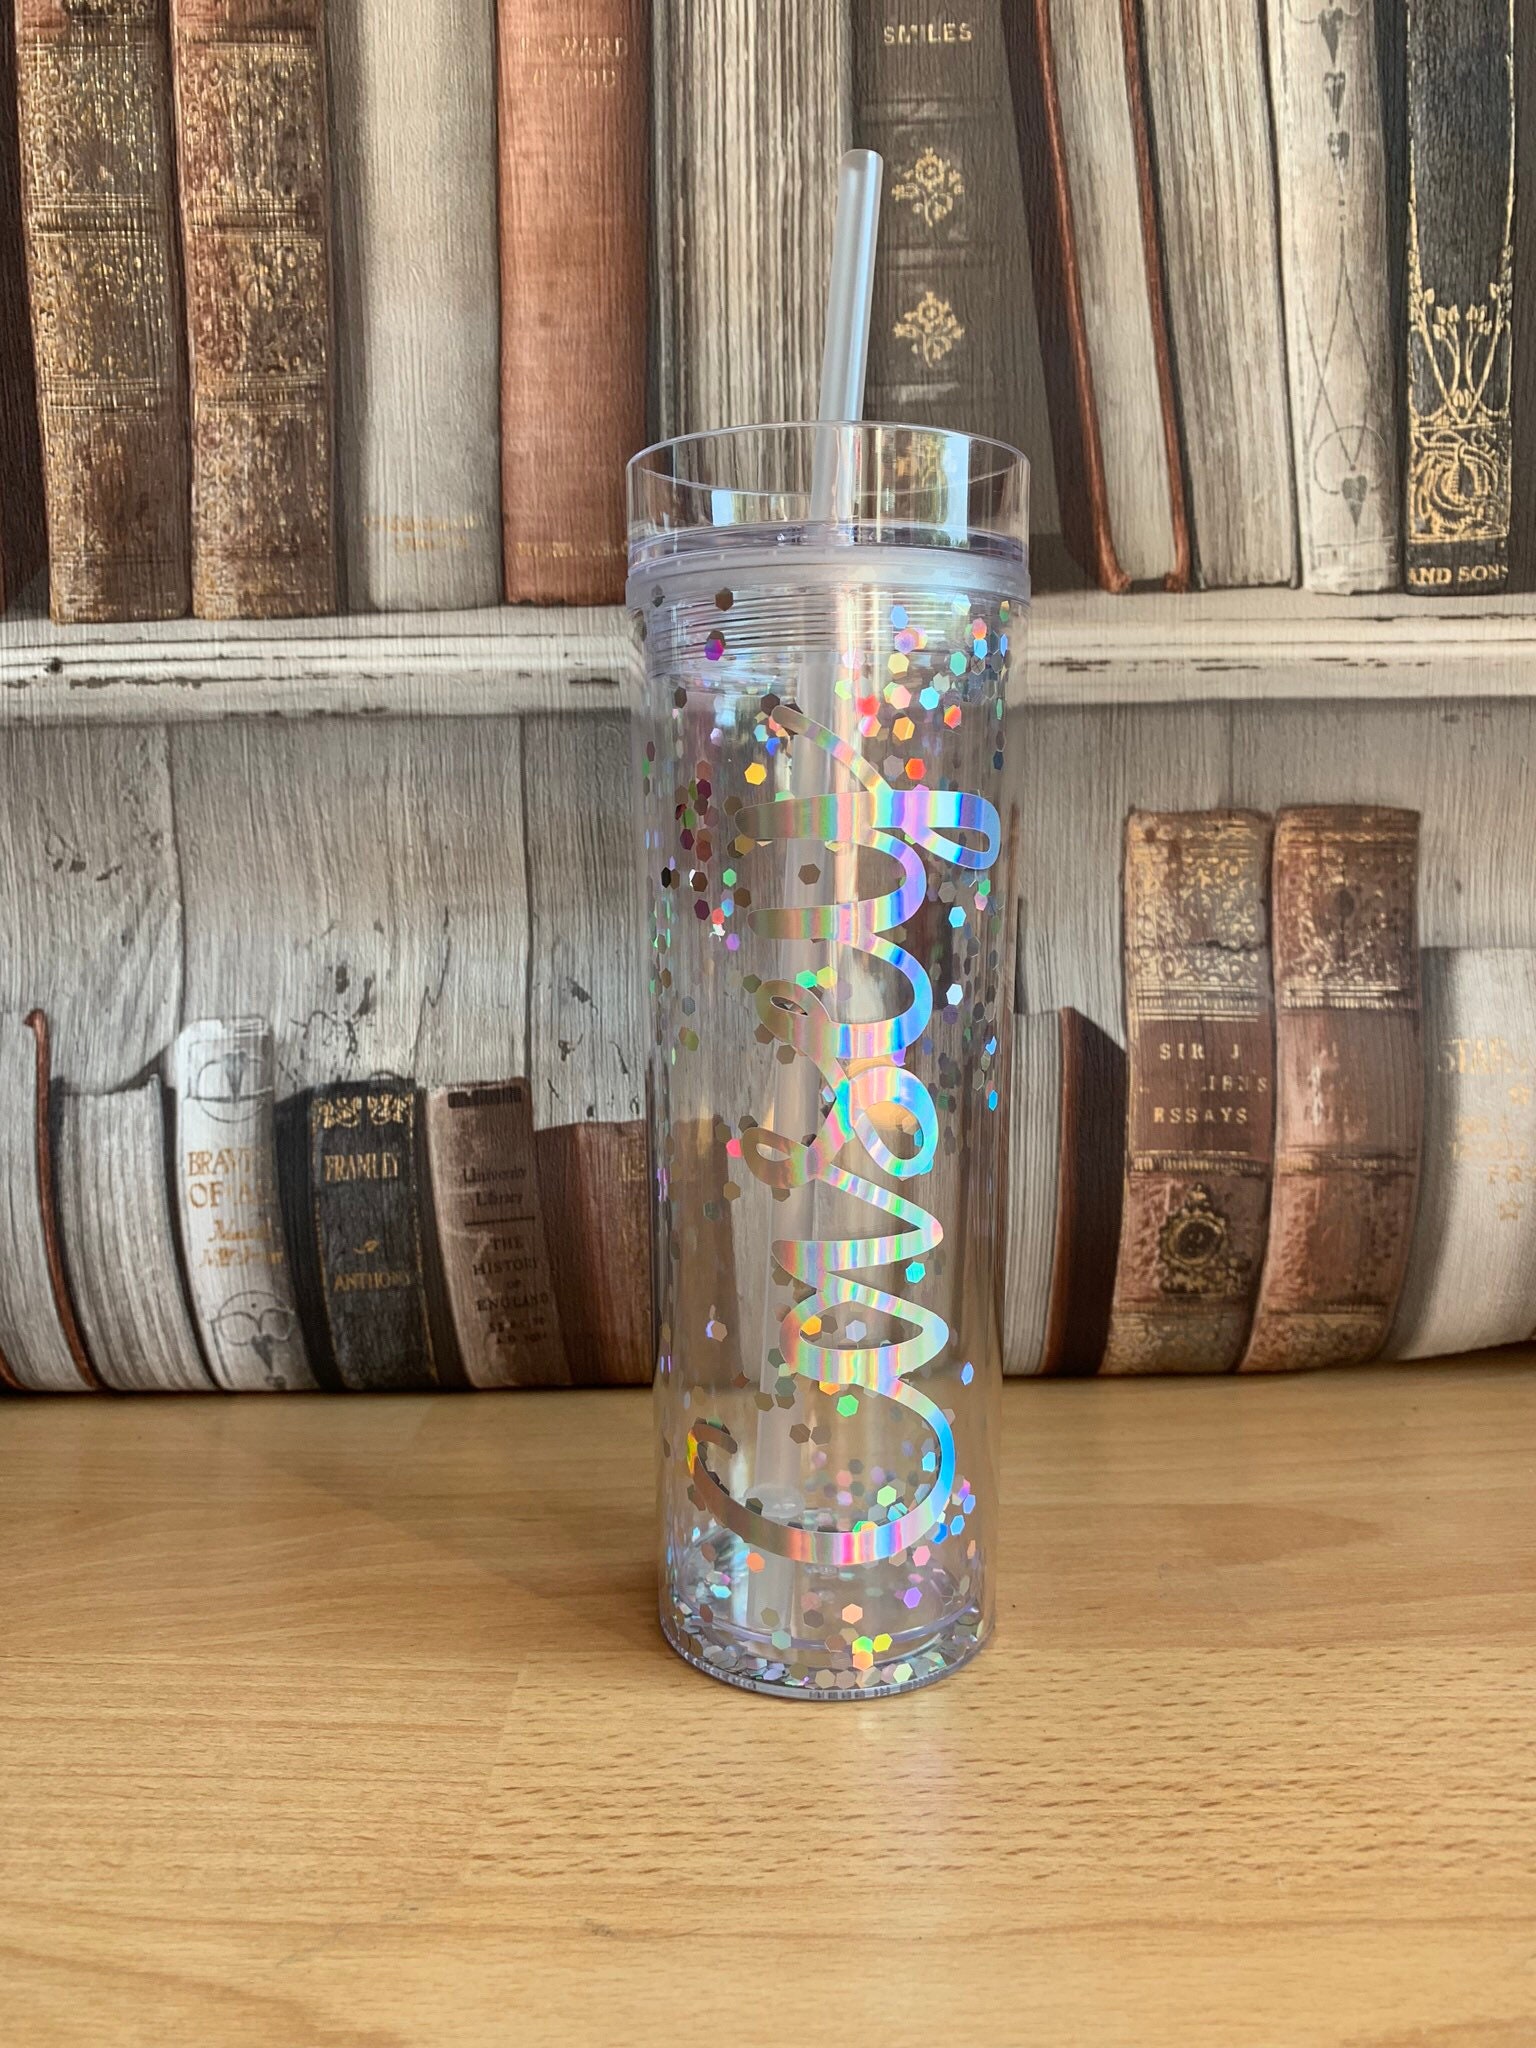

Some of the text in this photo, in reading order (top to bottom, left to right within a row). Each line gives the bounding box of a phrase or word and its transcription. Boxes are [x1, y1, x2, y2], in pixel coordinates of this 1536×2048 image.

[1408, 566, 1452, 587] AND
[1159, 1043, 1205, 1060] SIR
[686, 703, 1001, 1567] Casey
